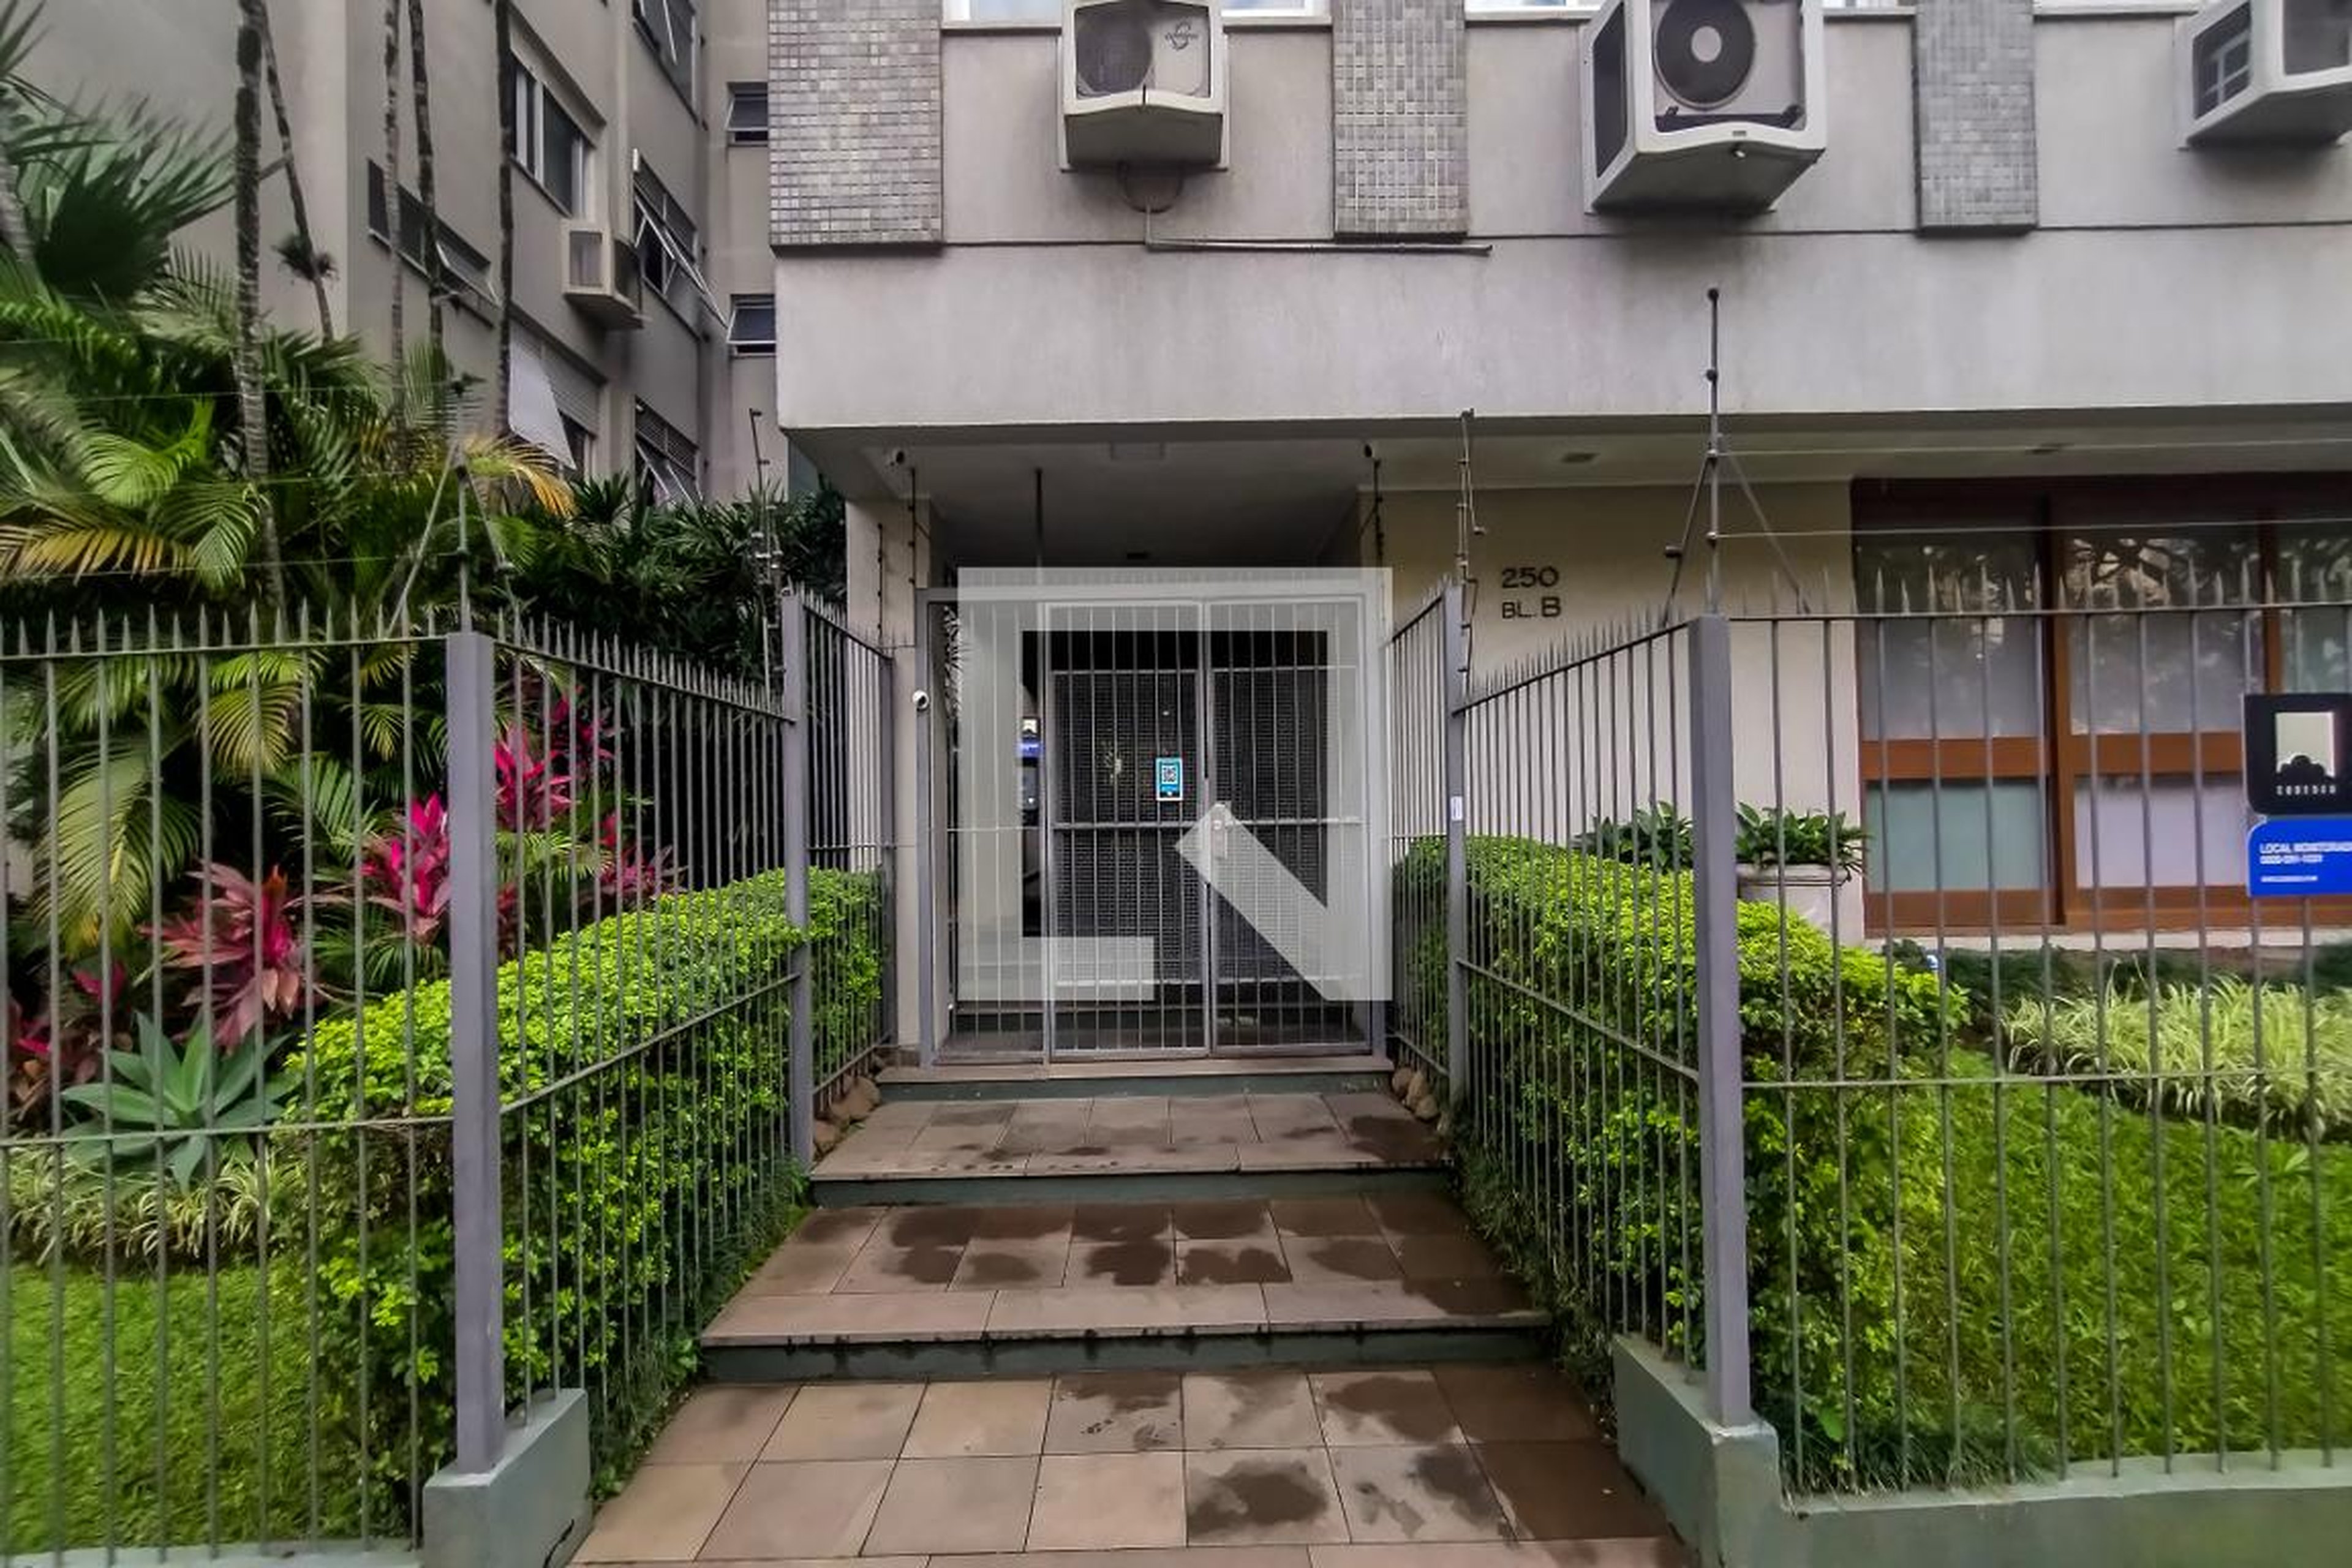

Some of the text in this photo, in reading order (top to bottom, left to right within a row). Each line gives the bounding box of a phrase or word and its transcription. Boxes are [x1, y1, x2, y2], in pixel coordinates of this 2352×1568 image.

[1502, 567, 1560, 588] 250
[1541, 597, 1561, 617] B
[2260, 843, 2291, 854] LOCAL
